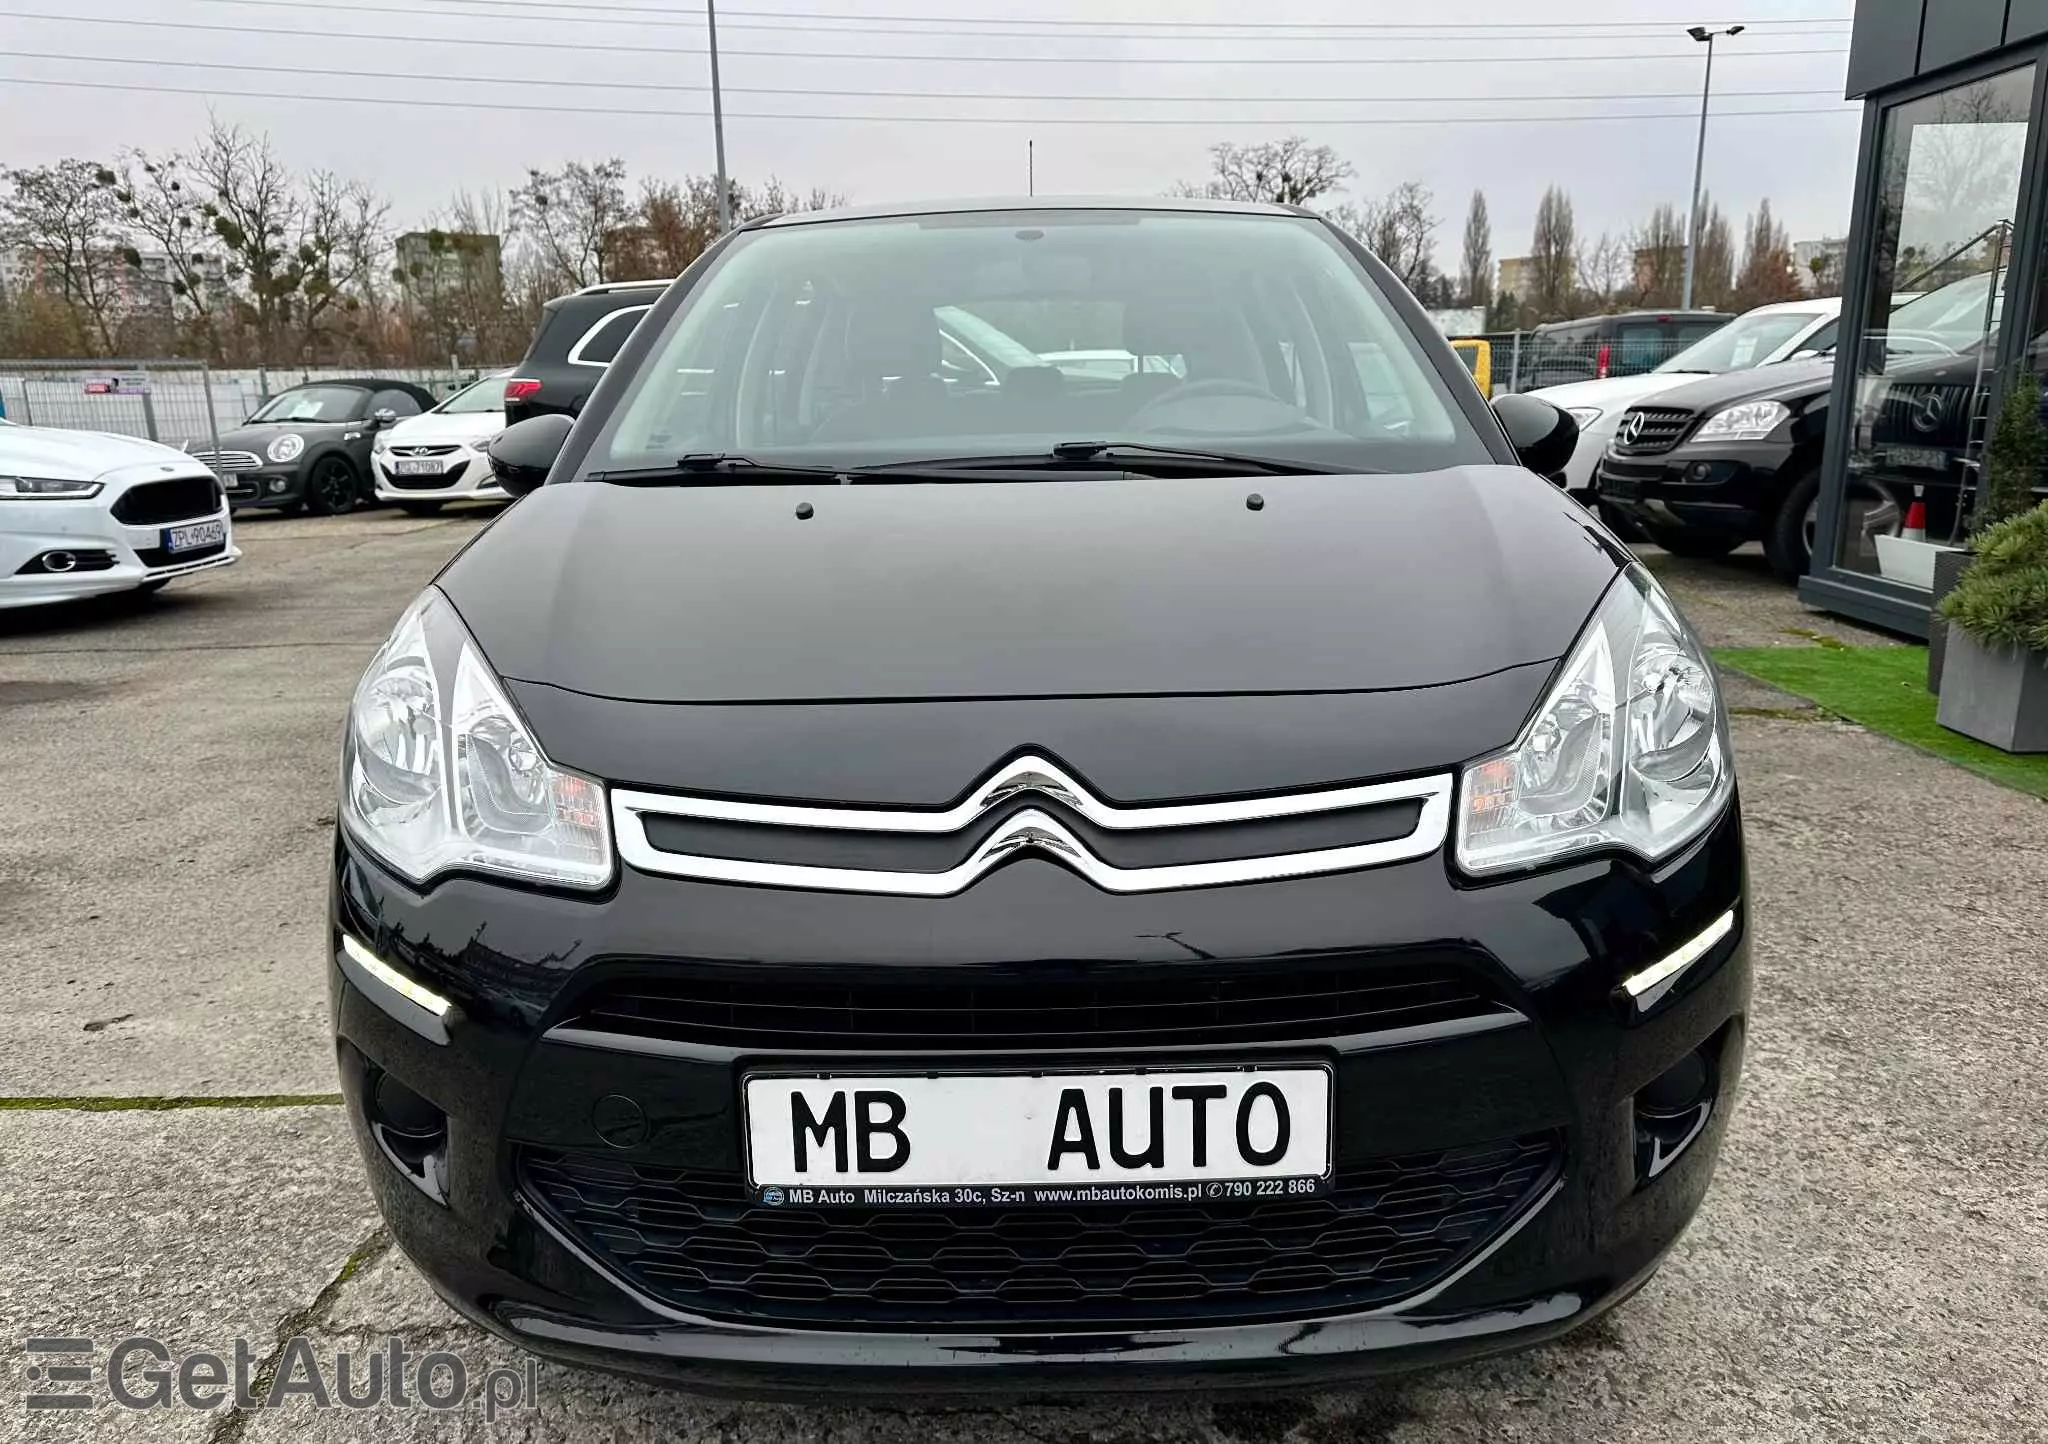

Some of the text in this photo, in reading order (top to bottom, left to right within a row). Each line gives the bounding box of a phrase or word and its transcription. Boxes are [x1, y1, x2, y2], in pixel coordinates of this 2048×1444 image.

[790, 1081, 1291, 1173] MB AUTO
[789, 1179, 1315, 1205] MB Auto Milczańska 30c, Sz-n www.mbautokomis.pl 790 222 866
